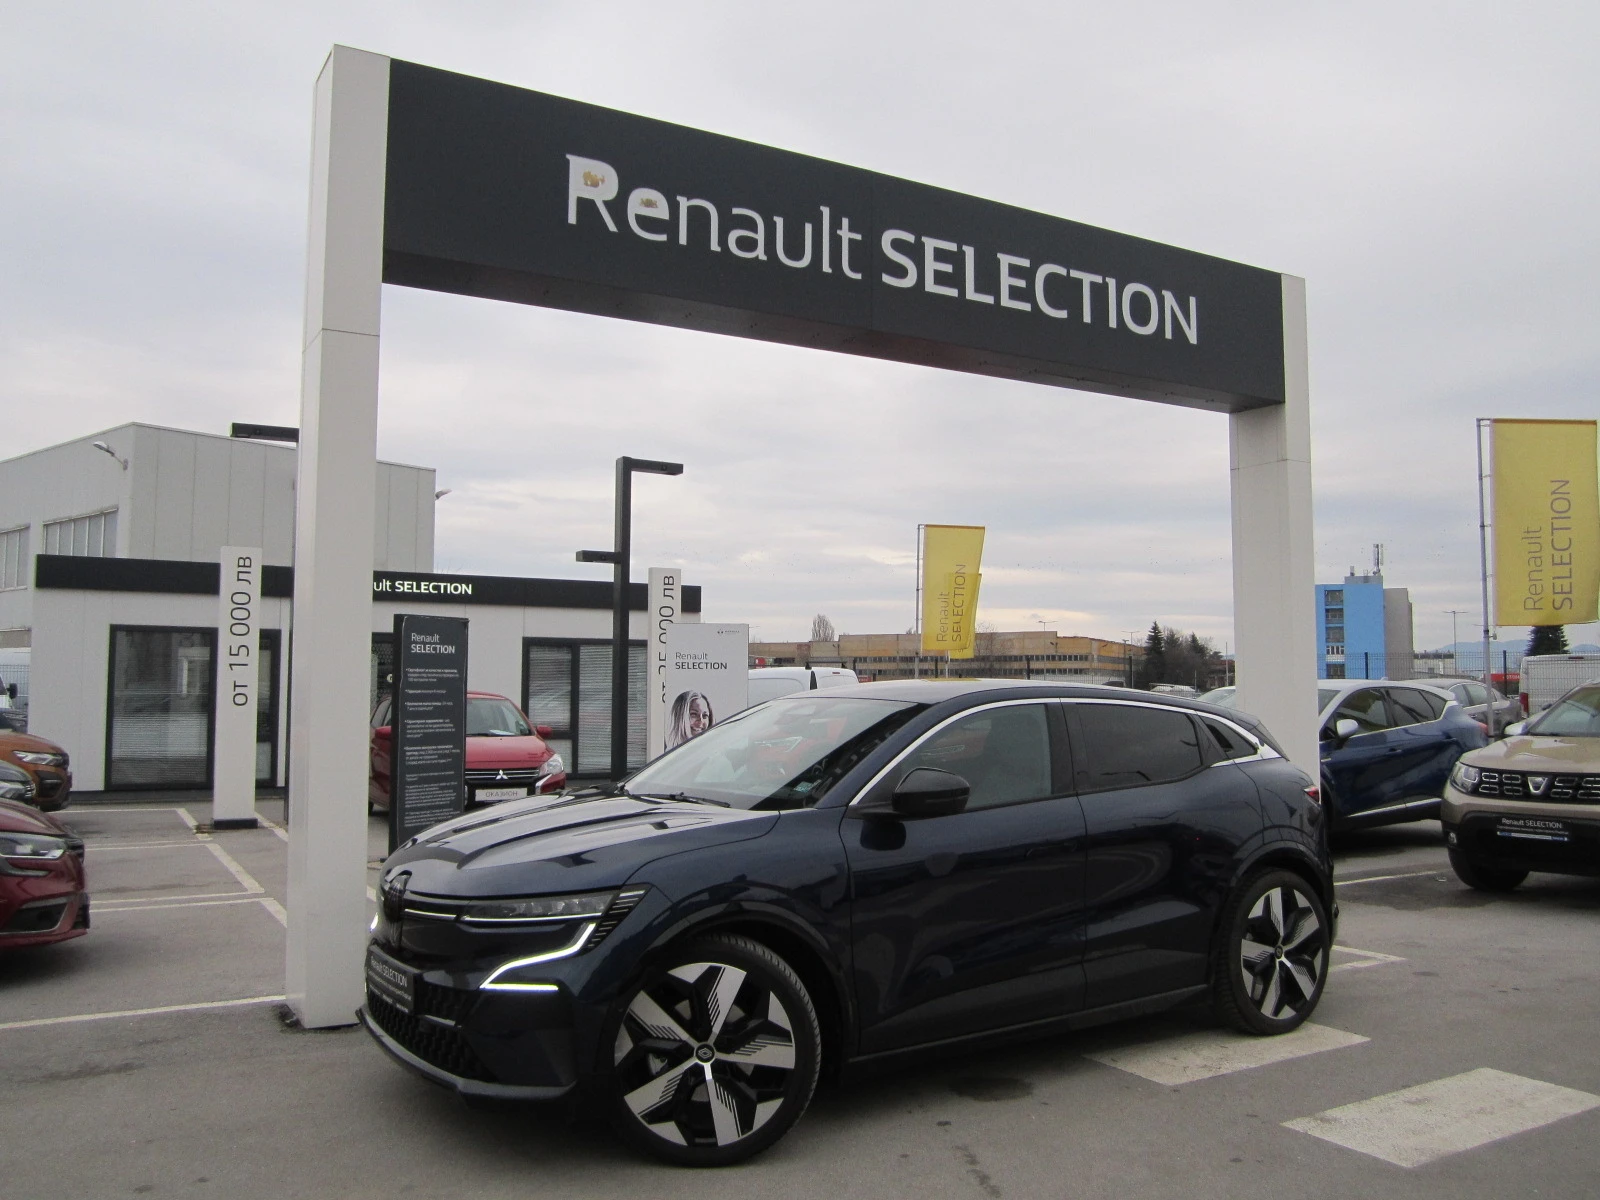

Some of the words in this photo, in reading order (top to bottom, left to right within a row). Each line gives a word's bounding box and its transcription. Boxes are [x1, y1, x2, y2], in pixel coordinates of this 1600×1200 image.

[566, 154, 862, 280] Renault
[881, 229, 1197, 345] SELECTION
[1550, 480, 1573, 611] SELECTION
[237, 556, 252, 585] лв
[1522, 526, 1543, 611] Renault
[394, 580, 472, 595] SELECTION
[230, 591, 251, 637] 000
[952, 564, 966, 642] SELECTION
[936, 591, 950, 642] Renault
[411, 633, 439, 643] Renault
[411, 644, 455, 654] SELECTION
[229, 644, 249, 671] 15
[675, 652, 708, 660] Renault
[675, 661, 728, 670] SELECTION
[233, 680, 248, 706] от
[1501, 818, 1525, 826] Renault
[1525, 820, 1562, 829] SELECTION
[382, 964, 408, 987] SELECTION
